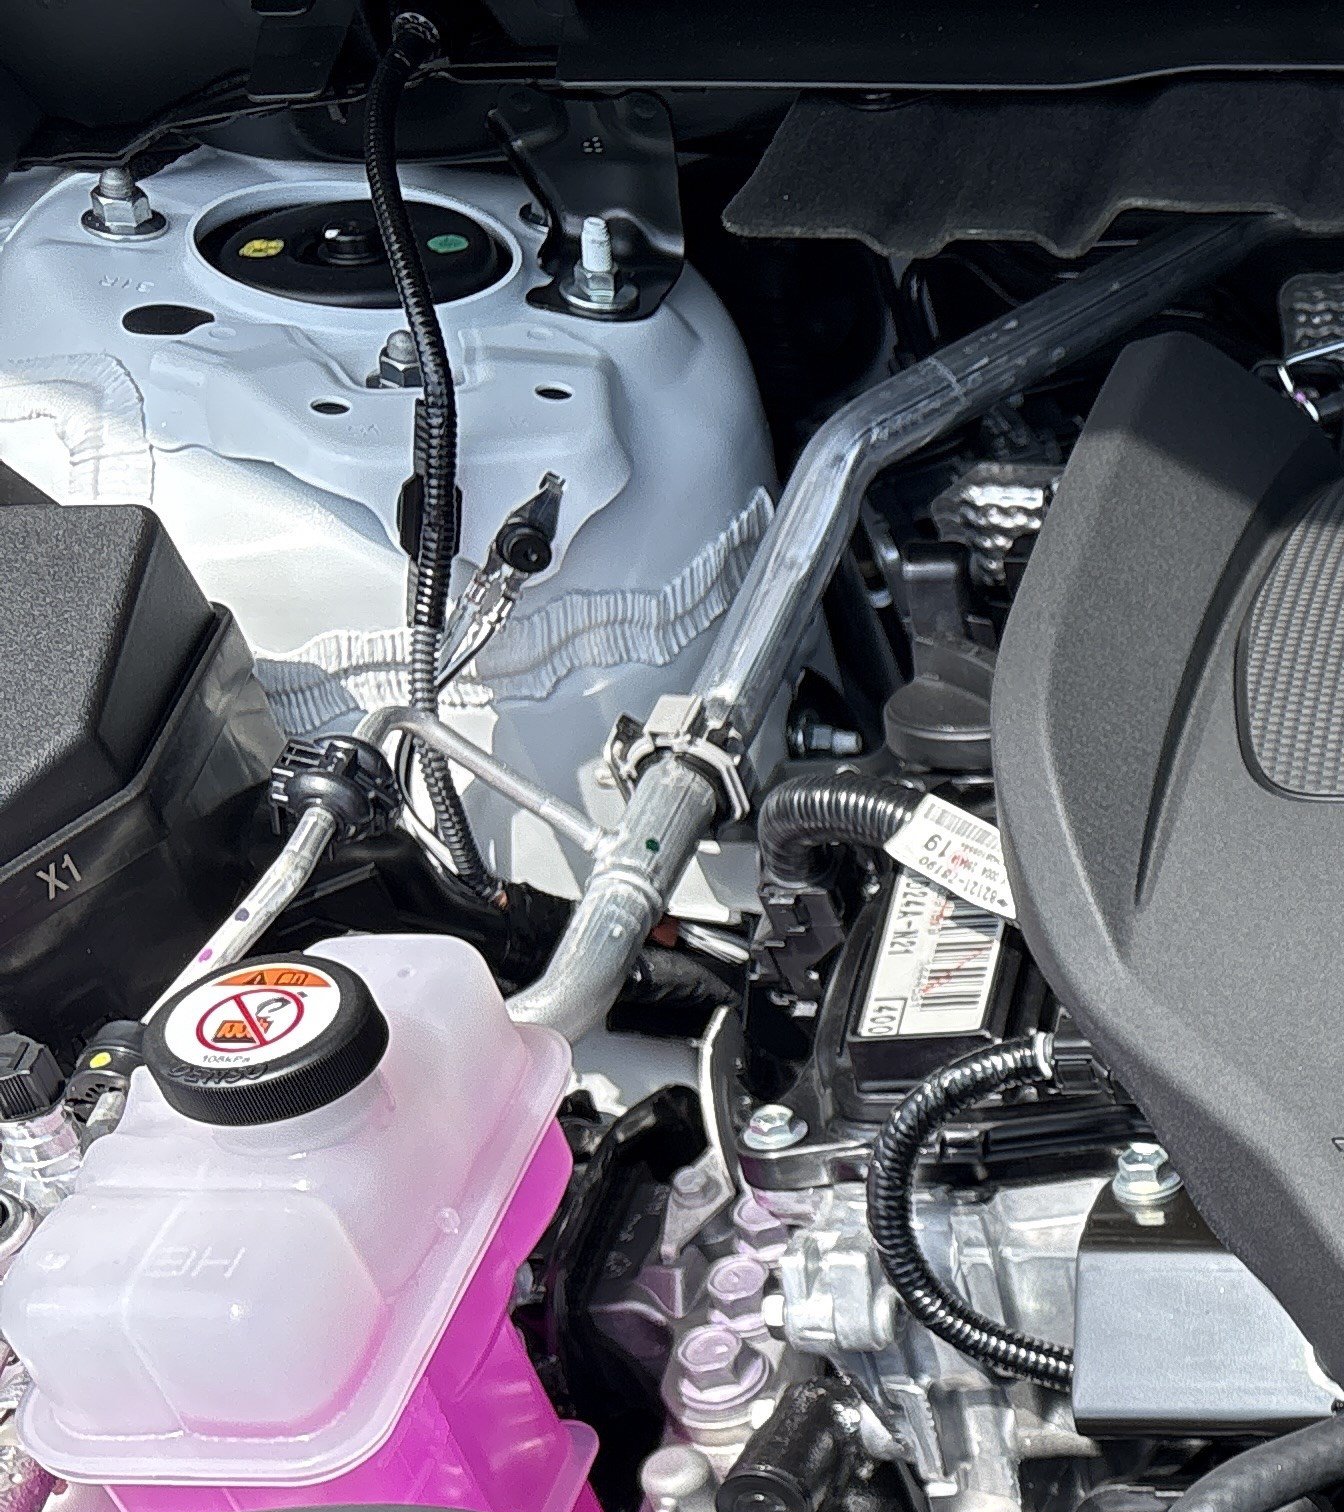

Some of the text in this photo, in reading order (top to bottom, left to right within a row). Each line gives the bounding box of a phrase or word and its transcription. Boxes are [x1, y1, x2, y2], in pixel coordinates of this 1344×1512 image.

[924, 834, 952, 858] 19
[35, 853, 84, 901] X1
[867, 1005, 899, 1035] 400
